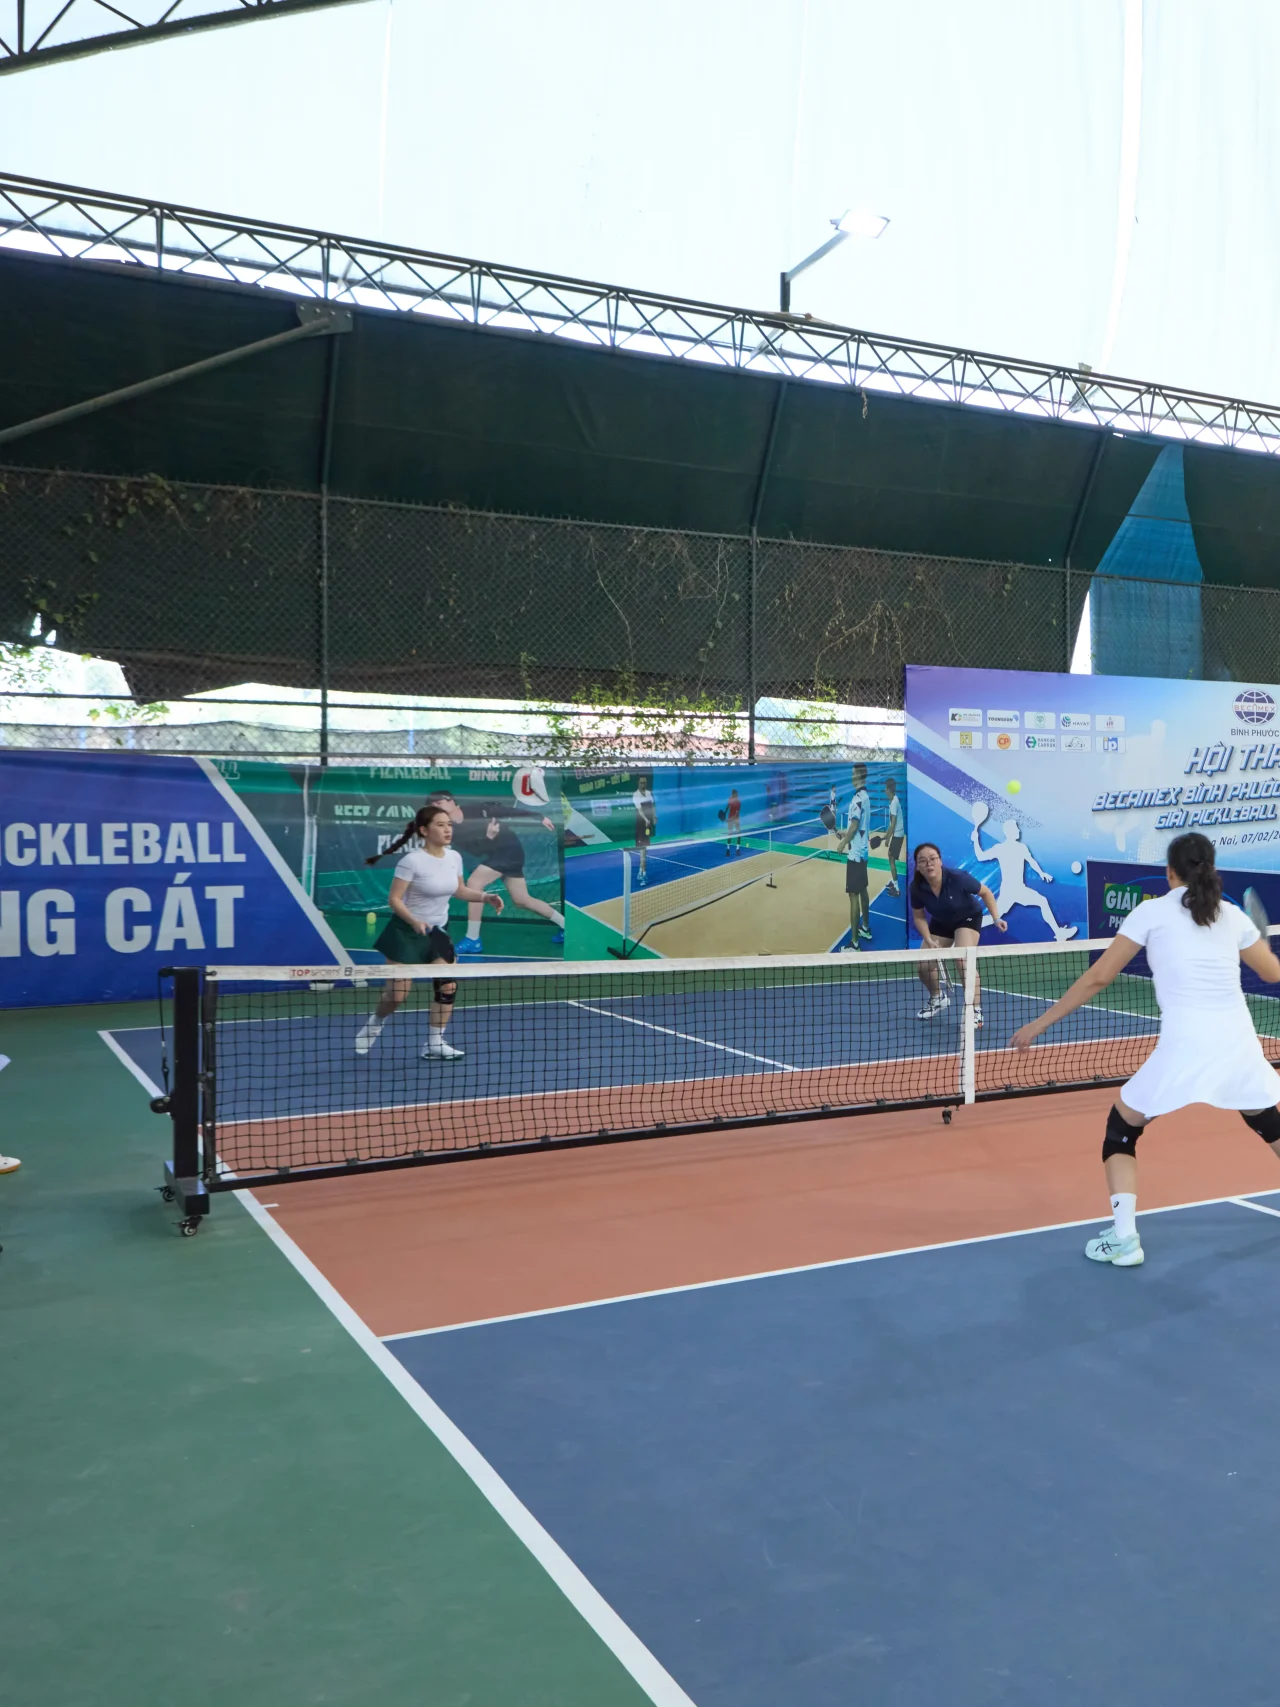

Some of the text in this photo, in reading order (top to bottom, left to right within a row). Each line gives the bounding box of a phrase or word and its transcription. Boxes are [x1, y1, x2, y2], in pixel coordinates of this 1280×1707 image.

[1092, 786, 1183, 811] BECAMEX
[1188, 804, 1278, 827] PICKLEBALL
[0, 822, 246, 867] CKLEBALL
[1219, 835, 1238, 846] Nai,
[105, 872, 245, 954] CÁT
